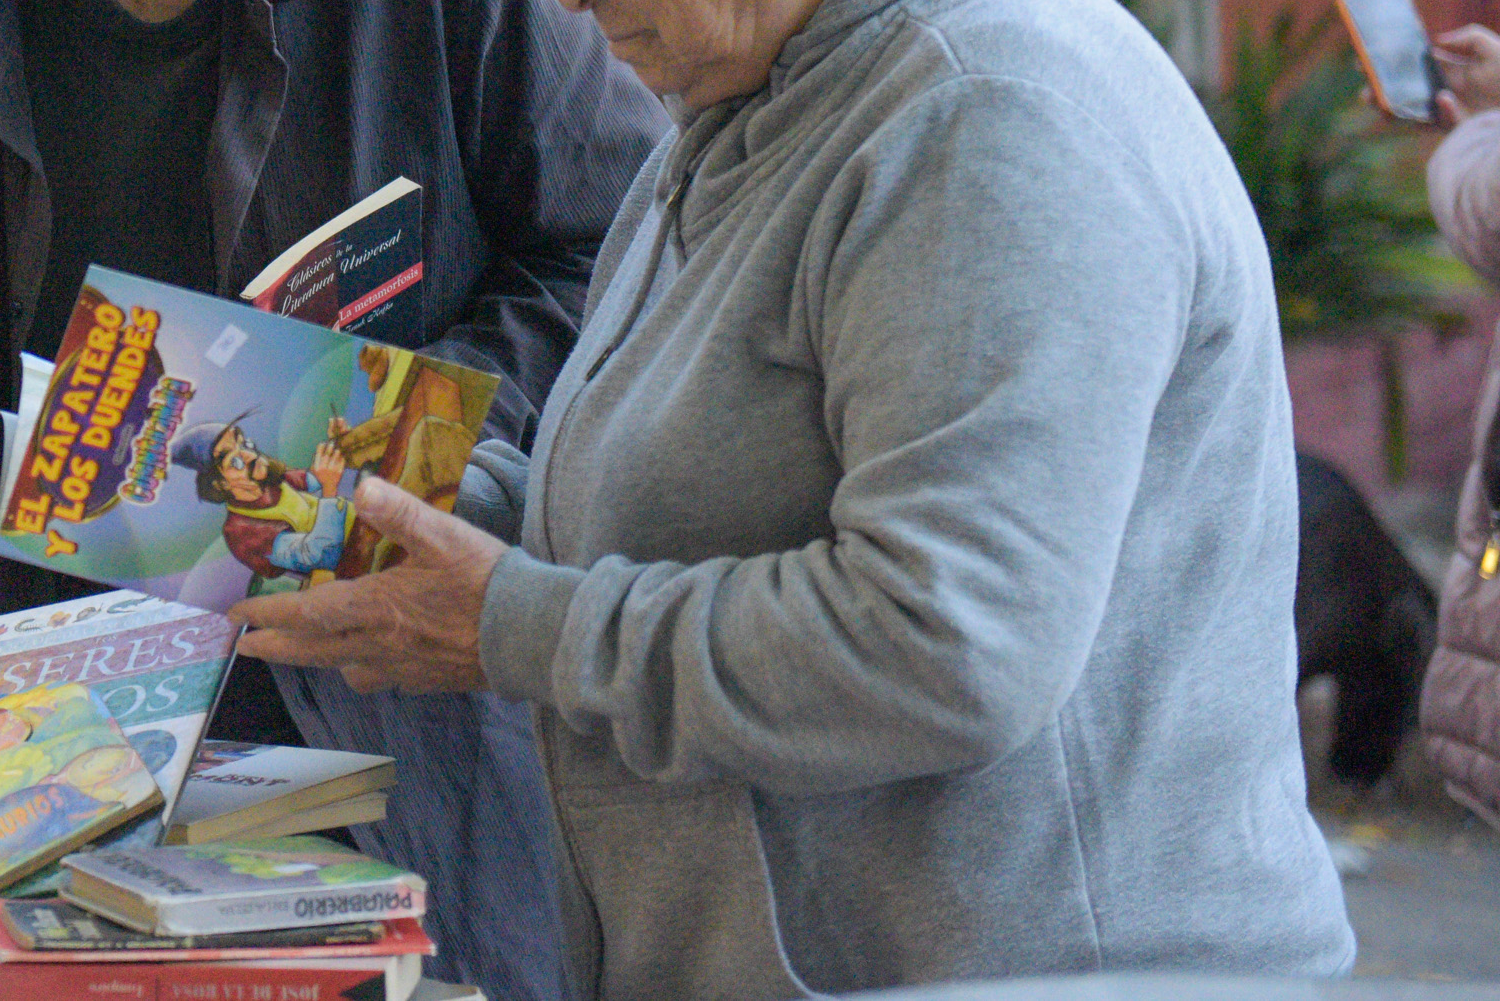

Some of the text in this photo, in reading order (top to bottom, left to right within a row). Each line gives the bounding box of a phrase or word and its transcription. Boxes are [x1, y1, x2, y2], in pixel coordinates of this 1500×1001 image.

[277, 228, 402, 320] Literatura Universal
[286, 252, 333, 294] Clásicos
[338, 266, 419, 323] La metamorfosis
[92, 304, 161, 450] DUENDES
[14, 302, 126, 536] EL ZAPATERO
[51, 459, 100, 525] LOS
[44, 528, 79, 560] Y
